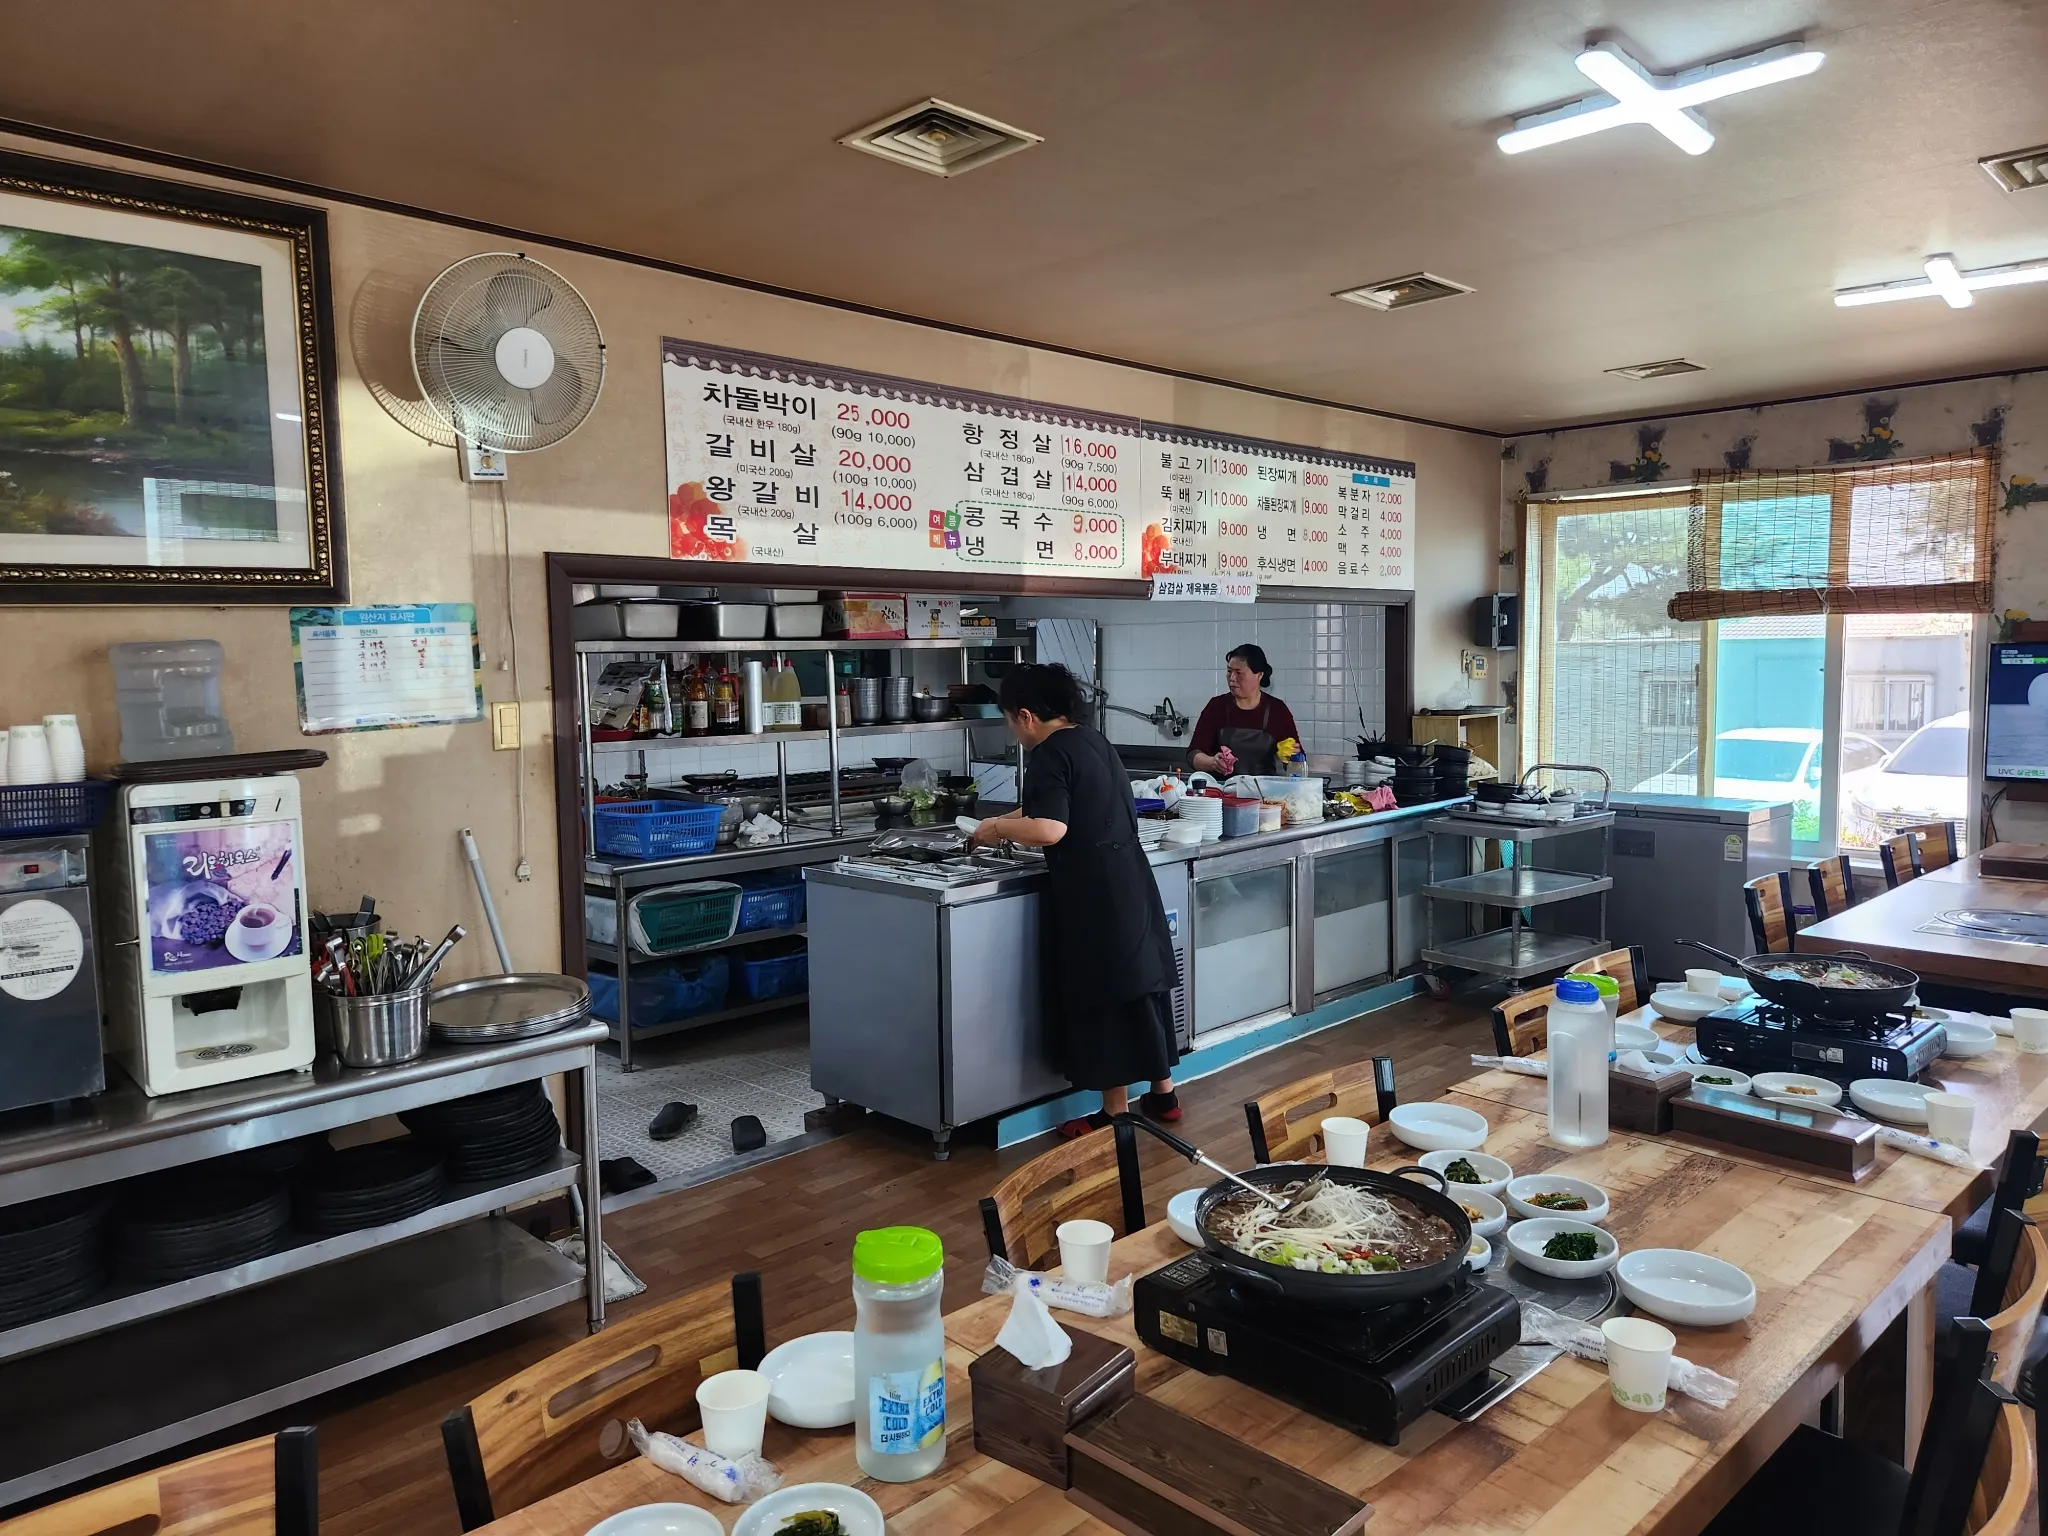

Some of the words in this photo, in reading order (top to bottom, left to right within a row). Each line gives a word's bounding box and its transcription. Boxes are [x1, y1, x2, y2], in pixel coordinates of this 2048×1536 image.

[703, 382, 817, 420] 차돌박이
[836, 403, 911, 429] 25,000
[723, 415, 753, 428] (국내산
[756, 417, 774, 430] 한우
[777, 420, 801, 434] 180g)
[831, 425, 862, 443] (90g
[868, 430, 916, 448] 10,000)
[1065, 436, 1117, 460] 16,000
[838, 449, 911, 473] 20,000
[980, 449, 1009, 461] (국내산
[1011, 452, 1035, 464] 180g)
[736, 463, 767, 475] (미국산
[769, 465, 793, 478] 200g)
[1060, 458, 1084, 472] (90g
[1087, 460, 1118, 474] 7,500)
[832, 472, 869, 487] (100g
[873, 475, 917, 490] 10,000)
[1169, 473, 1193, 484] (미국산)
[1257, 466, 1297, 485] 된장찌개
[1065, 475, 1117, 493] 14,000
[841, 490, 912, 512] 14,000
[980, 487, 1009, 499] (국내산
[1012, 490, 1036, 501] 180g)
[1061, 494, 1084, 507] (90g
[1087, 496, 1118, 509] 6,000)
[1376, 491, 1402, 505] 12,000
[737, 505, 768, 518] (국내산
[770, 506, 795, 520] 200g)
[1257, 495, 1297, 514] 차돌된장찌개
[1304, 500, 1328, 515] 9,000
[834, 513, 873, 528] (100g
[877, 514, 918, 530] 6,000)
[1073, 513, 1118, 534] 9,000
[1380, 511, 1402, 523] 4,000
[1161, 517, 1207, 536] 김치찌개
[1380, 528, 1402, 541] 4,000
[1302, 528, 1328, 543] 8,000
[751, 546, 784, 558] (국내산)
[1074, 543, 1118, 562] 8,000
[1161, 551, 1207, 569] 부대찌개
[1380, 546, 1402, 558] 4,000
[1257, 556, 1297, 573] 후식냉면
[1379, 565, 1401, 577] 2,000
[1158, 582, 1183, 595] 삼겹살
[1186, 582, 1218, 596] 제육볶음
[1226, 585, 1251, 596] 14,000
[359, 612, 386, 624] 원산지
[389, 612, 416, 622] 표시판
[1998, 768, 2015, 776] UVC
[879, 1395, 910, 1416] EXTRA
[925, 1397, 943, 1417] COLD
[883, 1415, 909, 1431] COLD
[881, 1434, 889, 1443] 더
